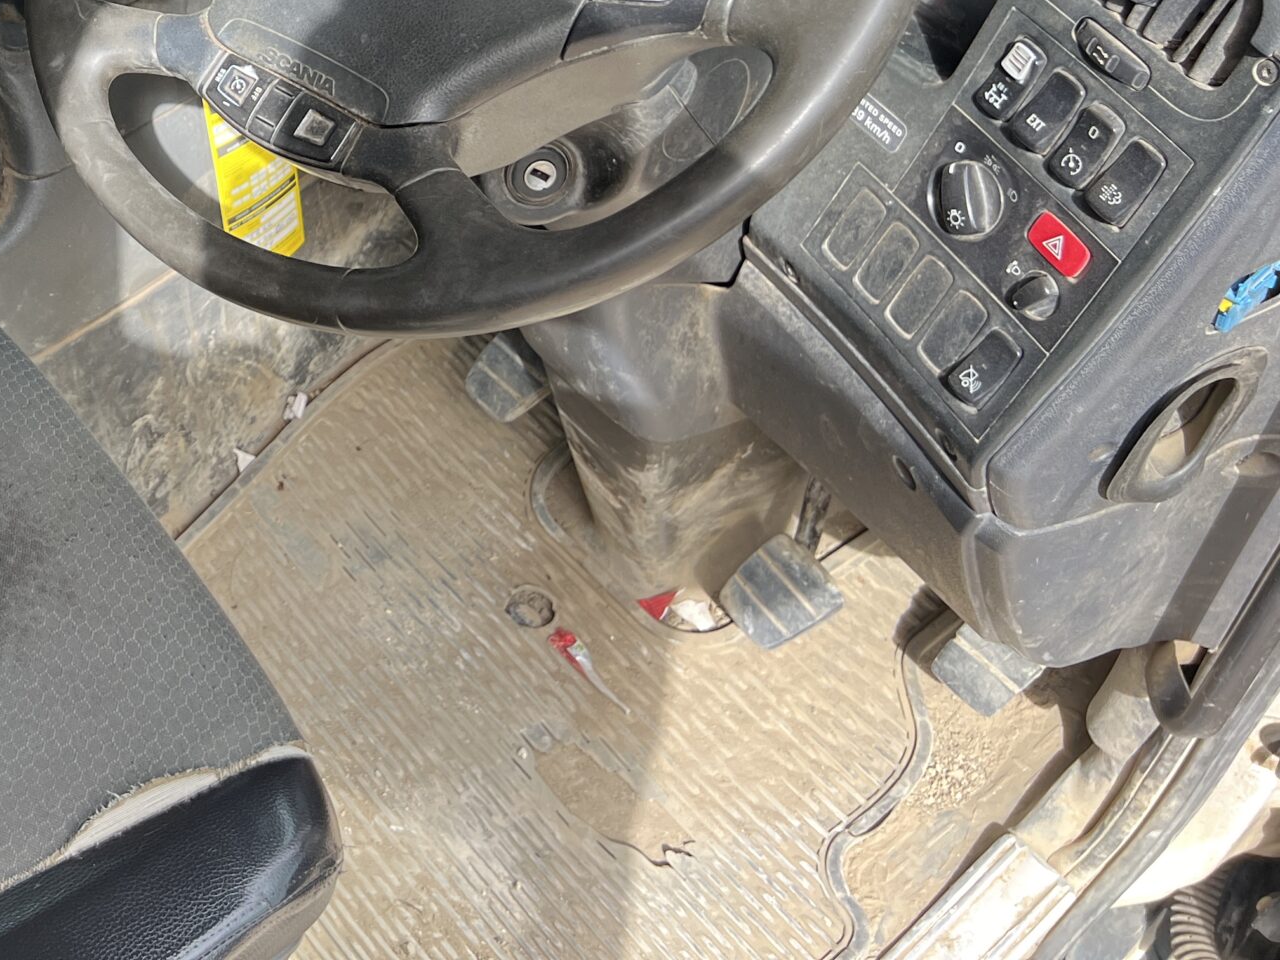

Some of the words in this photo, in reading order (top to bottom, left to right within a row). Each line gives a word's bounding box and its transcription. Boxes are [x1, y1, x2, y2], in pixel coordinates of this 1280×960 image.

[258, 46, 336, 97] SCANIA
[864, 116, 891, 145] km/h
[878, 113, 903, 137] SPEED
[1025, 113, 1046, 132] EXT
